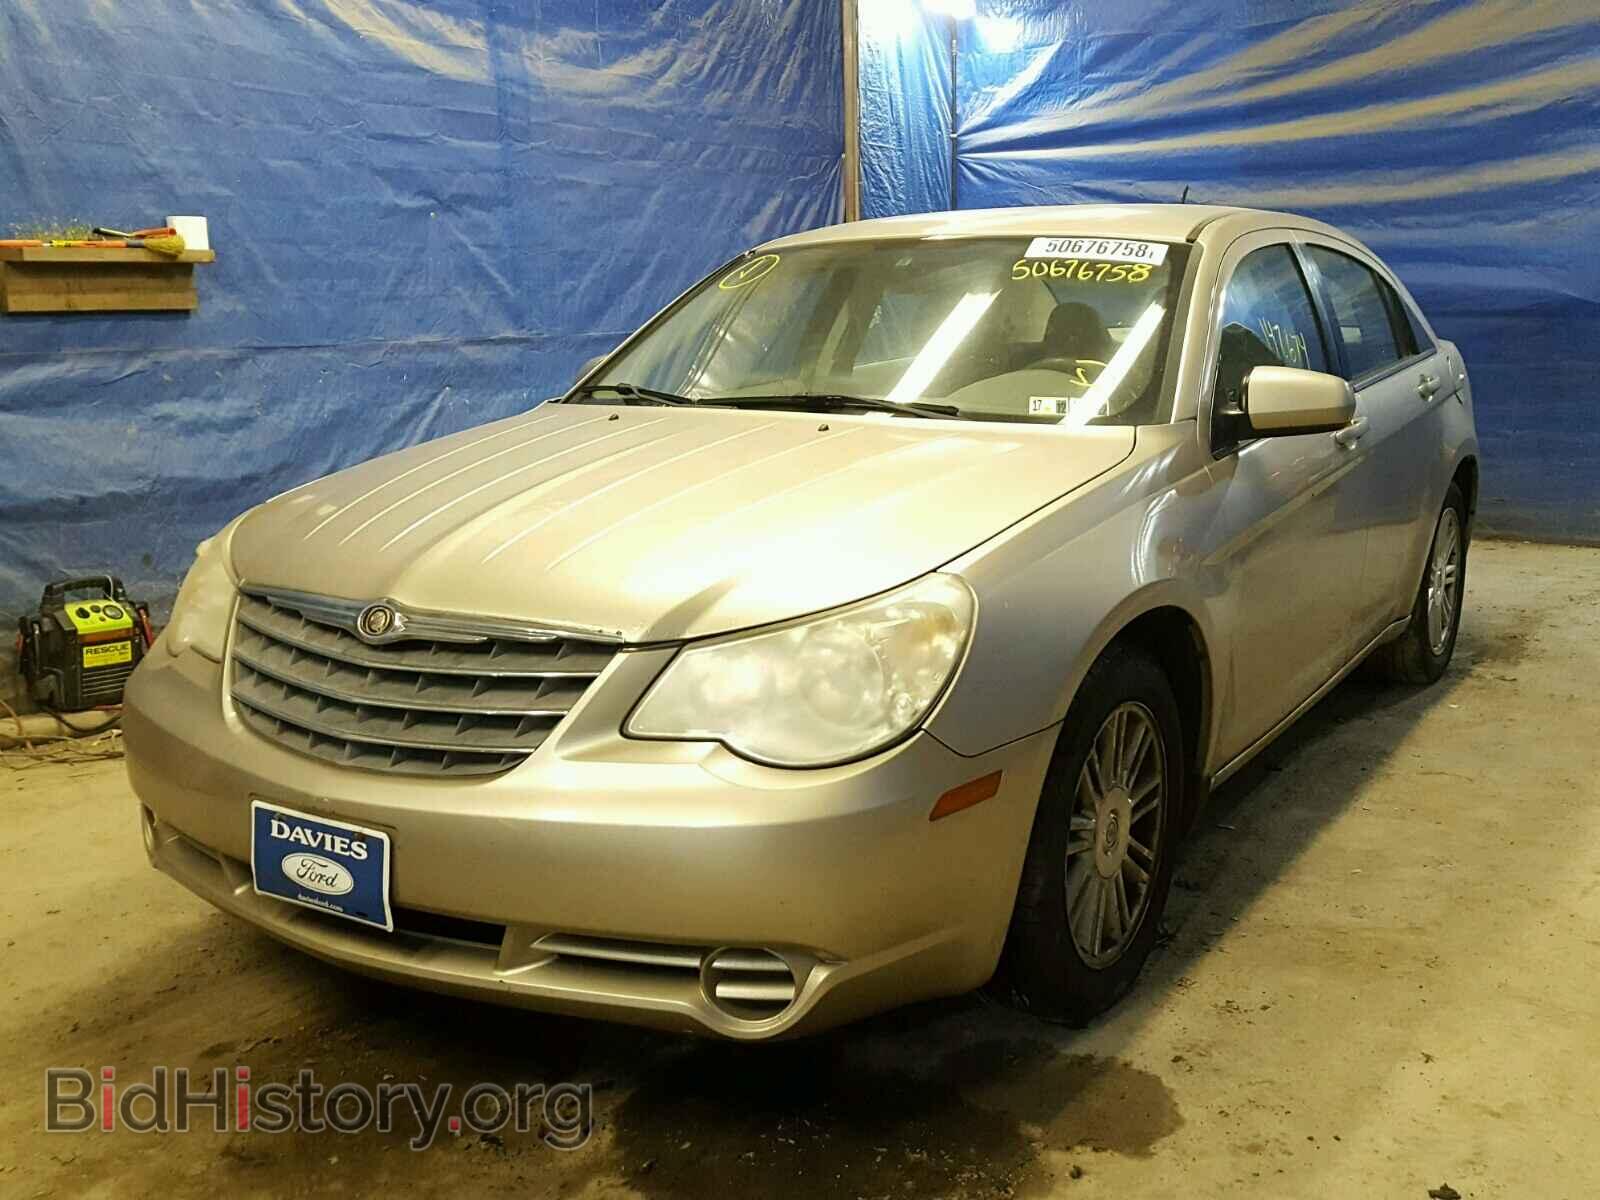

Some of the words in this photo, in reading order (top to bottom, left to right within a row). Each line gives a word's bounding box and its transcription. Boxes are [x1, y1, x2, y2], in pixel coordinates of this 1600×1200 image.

[1045, 239, 1149, 258] 50676758
[1011, 258, 1153, 283] 50676758
[86, 643, 129, 655] RESCUE
[270, 818, 368, 860] DAVIES
[296, 858, 339, 888] Ford
